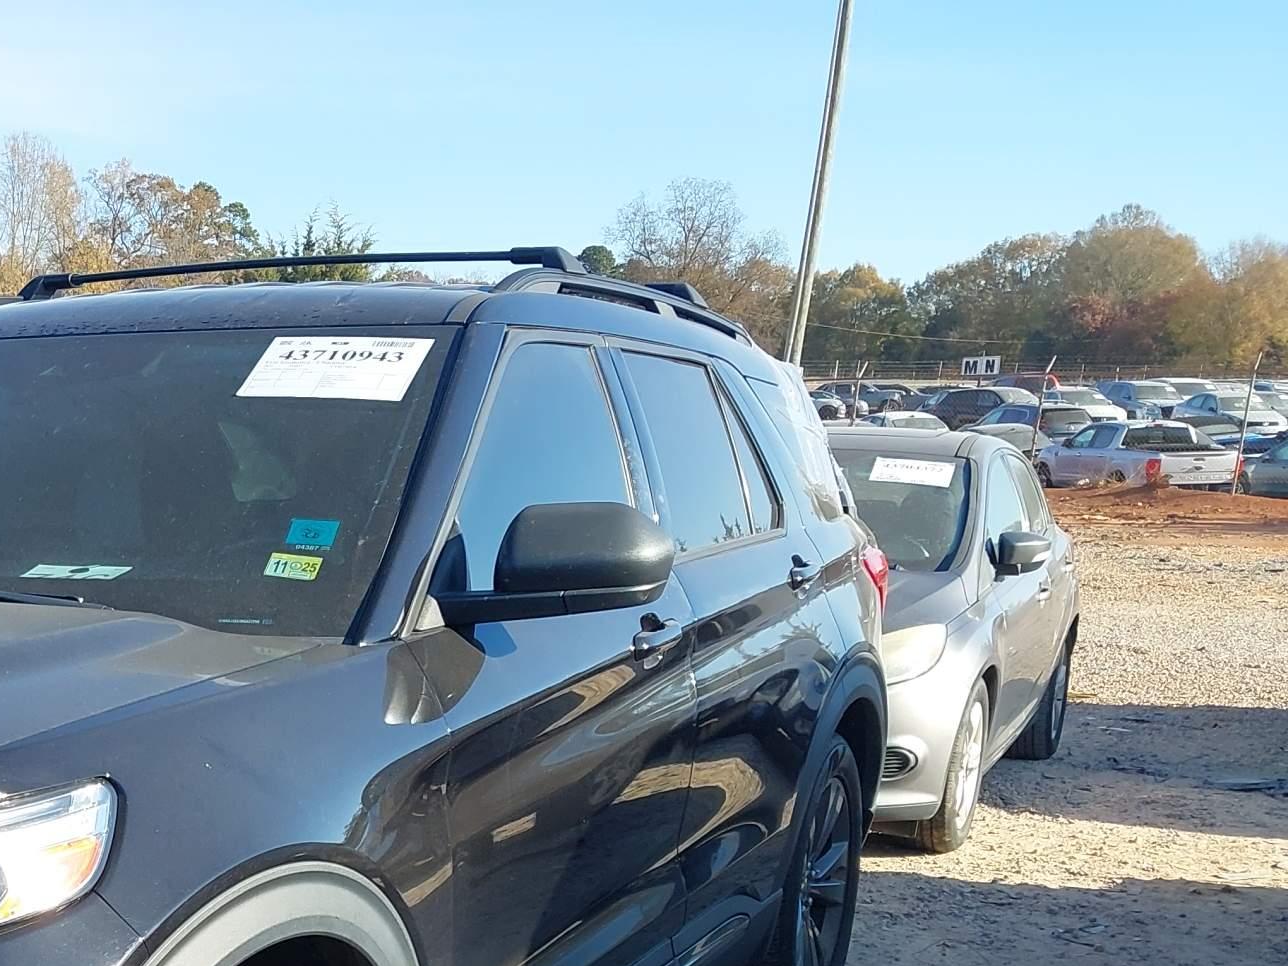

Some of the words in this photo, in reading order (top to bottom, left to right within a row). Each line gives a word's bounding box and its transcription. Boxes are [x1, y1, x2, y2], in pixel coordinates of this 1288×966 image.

[278, 349, 404, 363] 43710943
[964, 360, 979, 375] M
[985, 359, 996, 374] N
[272, 559, 288, 574] 11
[301, 561, 318, 573] 25
